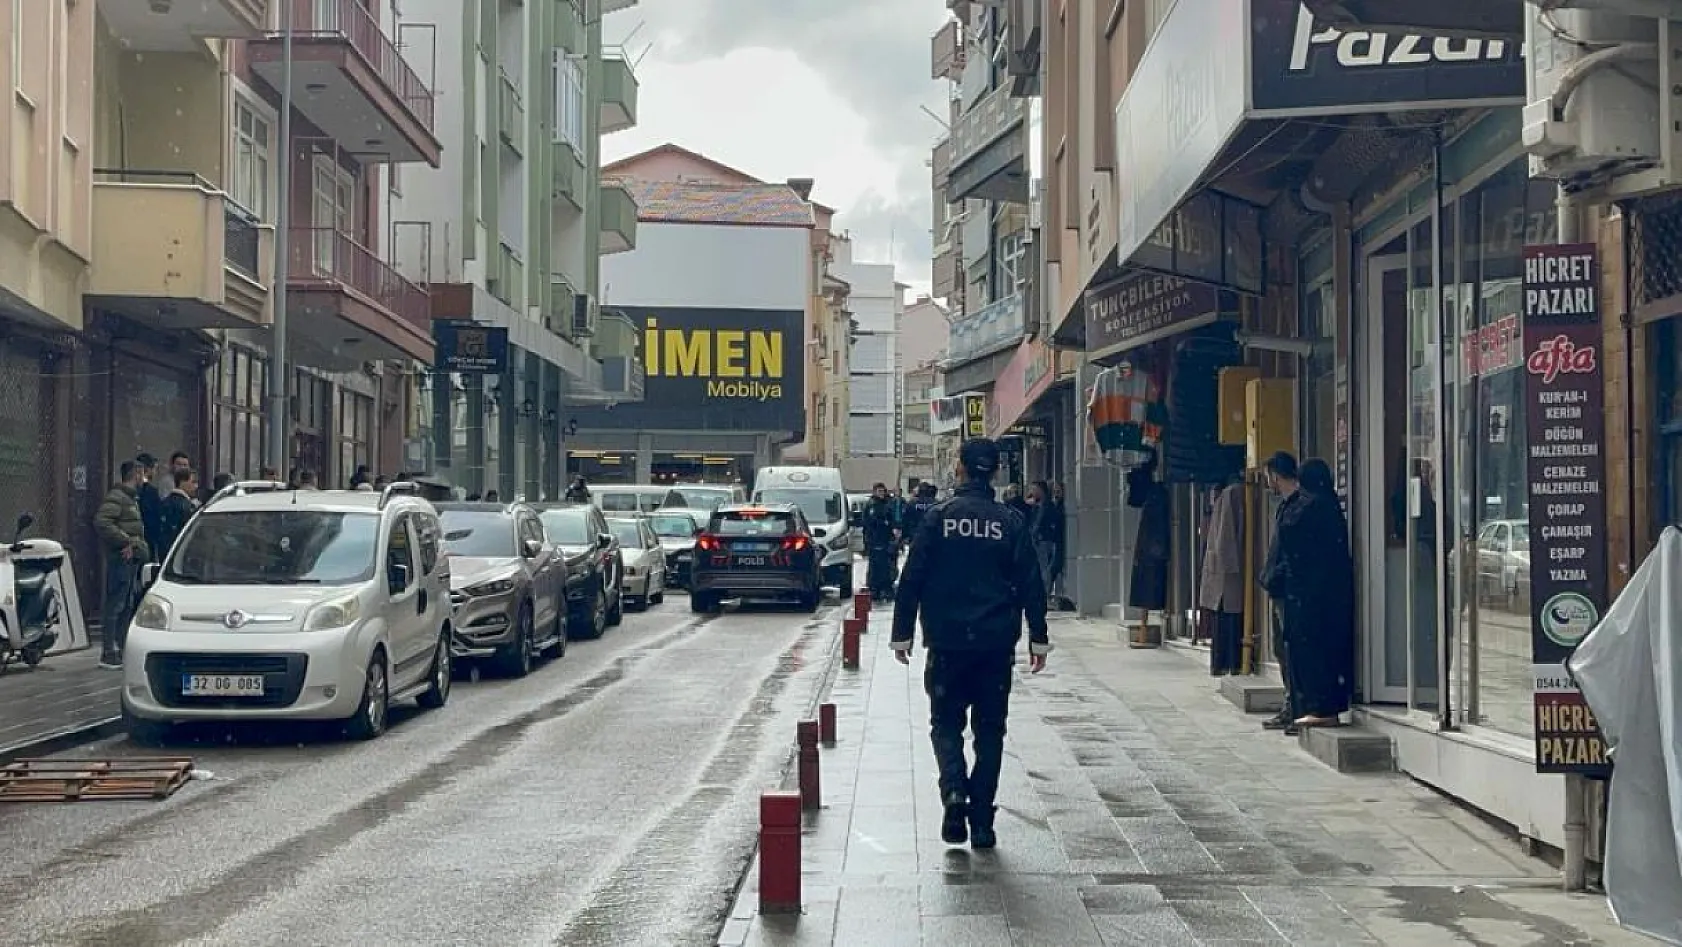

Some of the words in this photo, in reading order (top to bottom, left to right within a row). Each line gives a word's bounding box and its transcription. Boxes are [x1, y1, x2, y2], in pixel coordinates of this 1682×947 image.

[1525, 252, 1592, 284] HİCRET
[1526, 286, 1595, 316] PAZARI
[644, 317, 784, 379] İMEN
[707, 380, 782, 402] Mobilya
[1545, 405, 1582, 419] KERİM
[1543, 465, 1587, 478] CENAZE
[1547, 503, 1585, 519] ÇORAP
[1541, 525, 1592, 541] ÇAMAŞIR
[1550, 547, 1585, 562] EŞARP
[1549, 569, 1588, 581] YAZMA
[193, 677, 207, 690] 32
[1539, 700, 1597, 732] HİCRE
